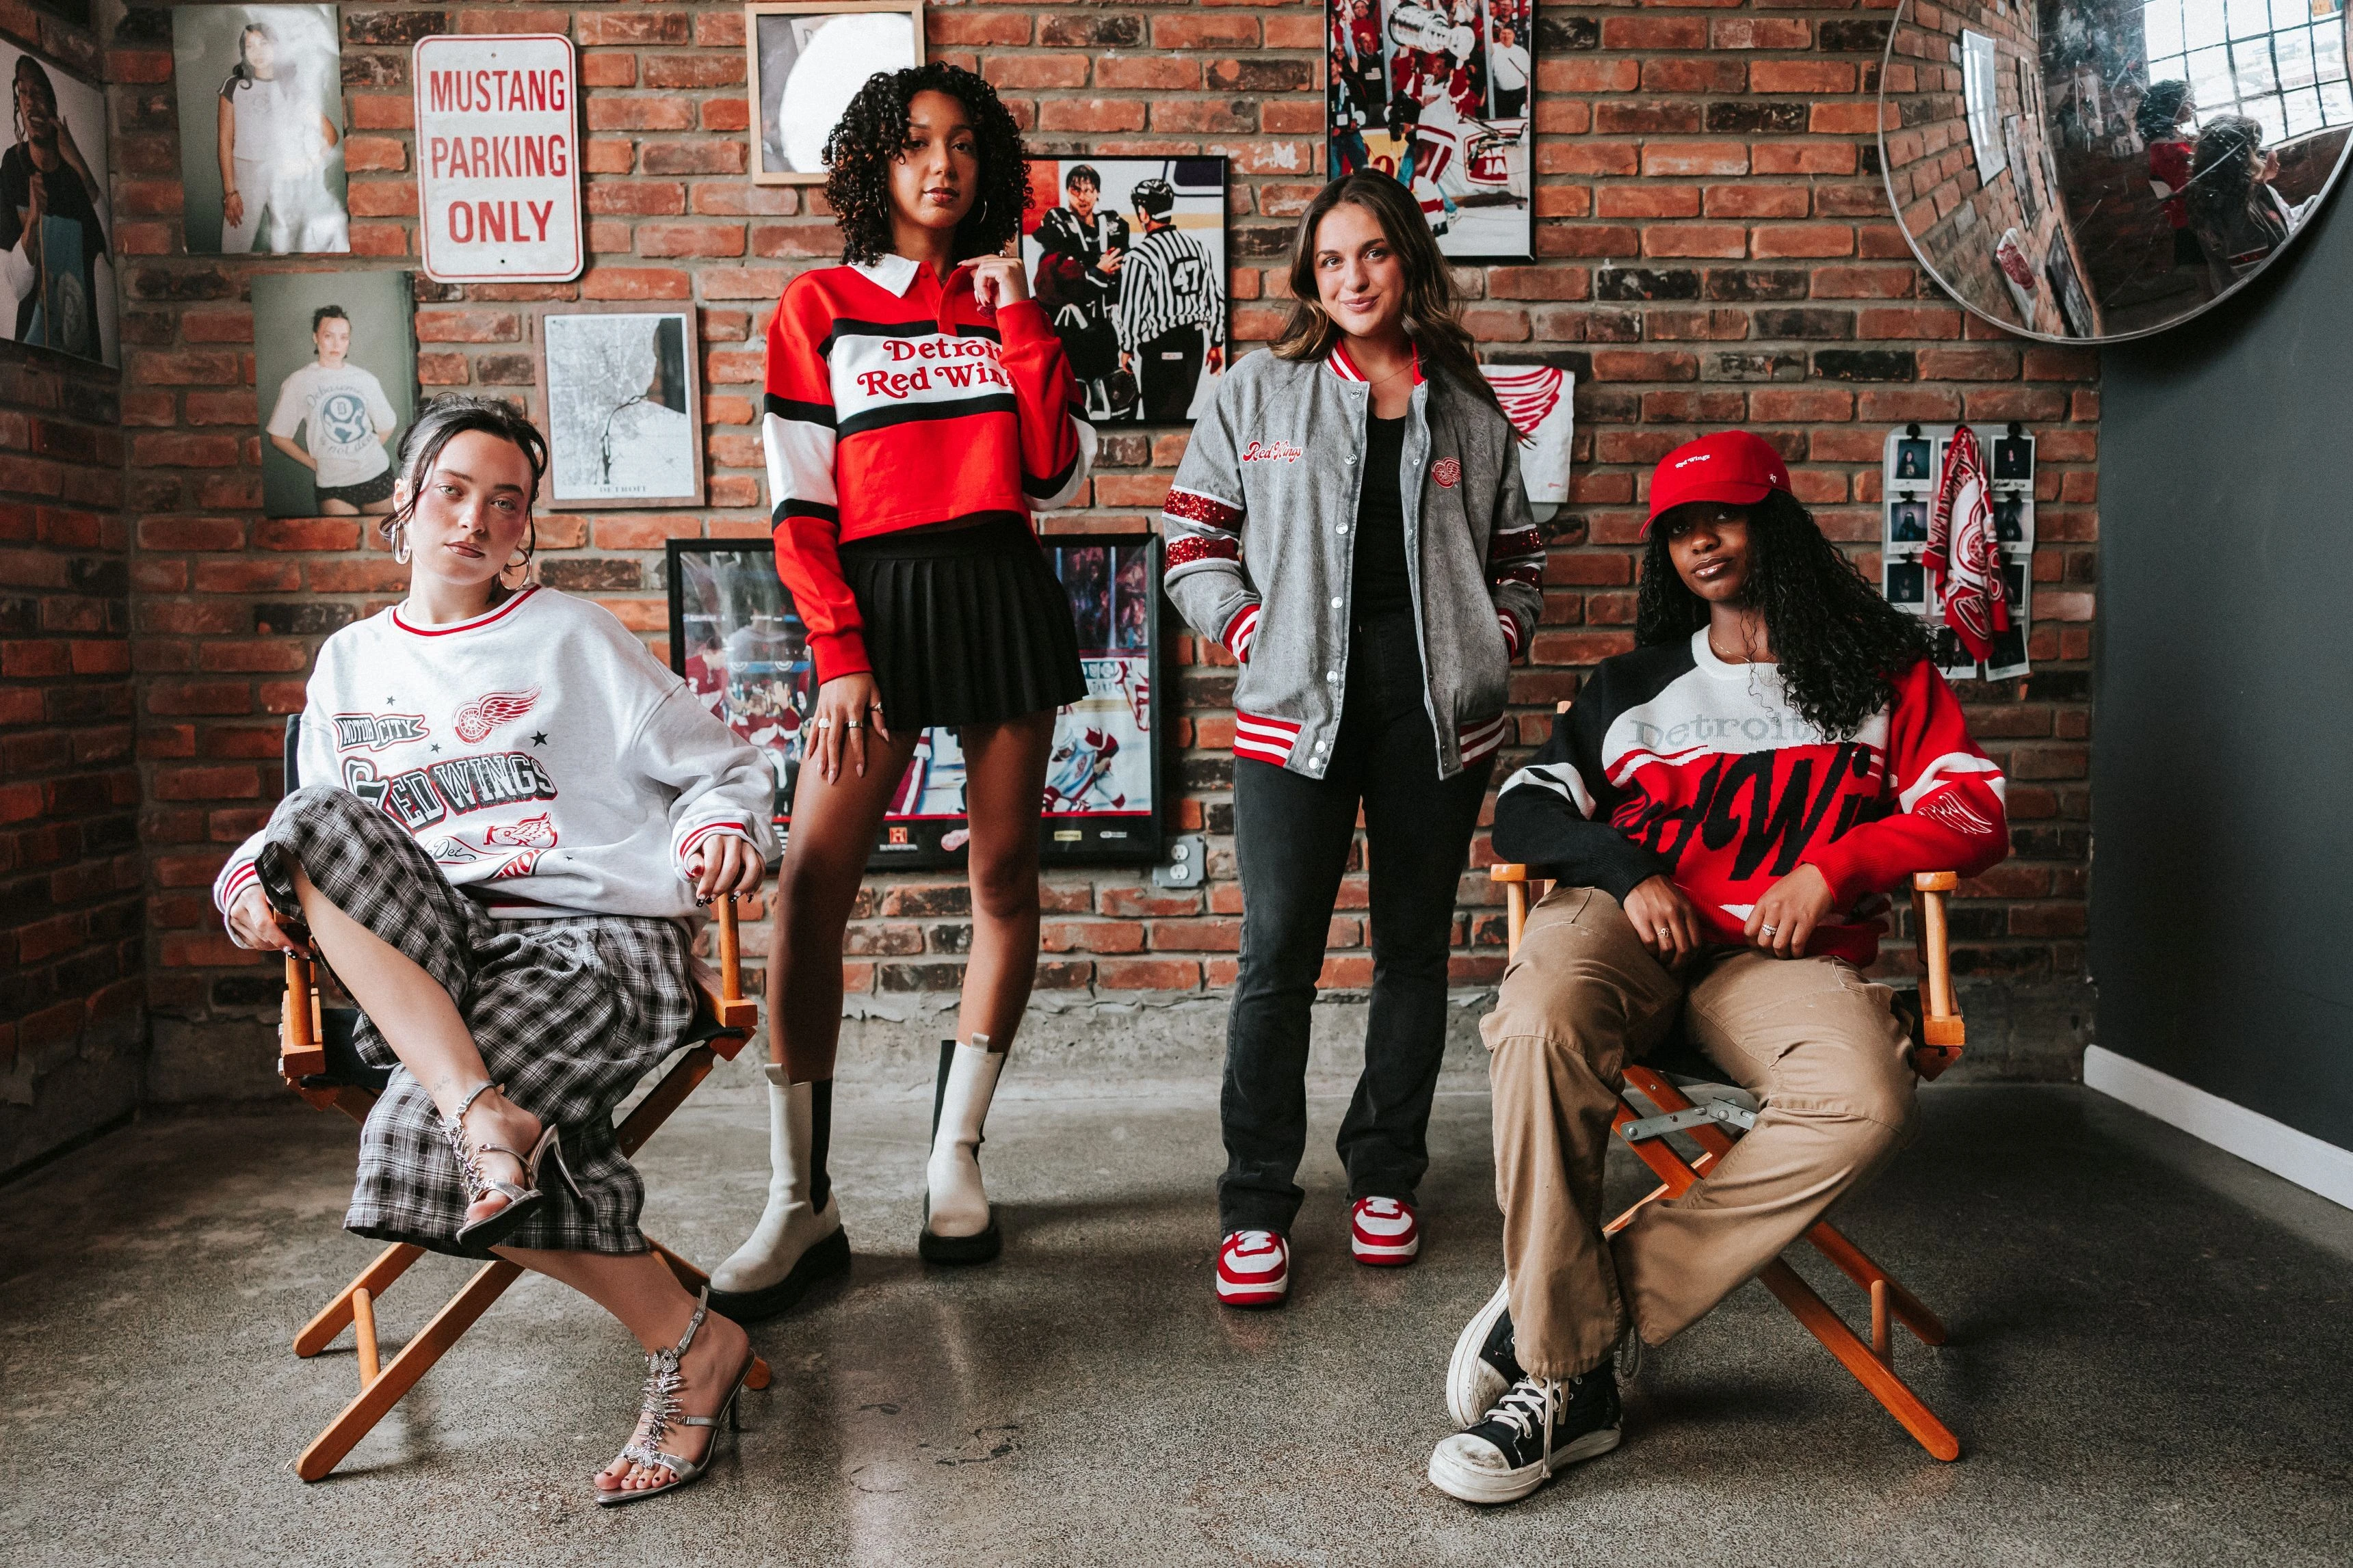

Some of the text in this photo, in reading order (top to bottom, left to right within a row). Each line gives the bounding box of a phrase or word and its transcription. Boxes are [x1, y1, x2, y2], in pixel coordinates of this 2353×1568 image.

[430, 69, 565, 112] MUSTANG
[431, 134, 567, 178] PARKING
[448, 200, 554, 243] ONLY
[1172, 259, 1200, 293] 47
[857, 361, 1016, 399] Red Win
[1242, 440, 1303, 464] Red Wings
[1675, 454, 1711, 468] Red Wings
[339, 718, 413, 744] MOTOR CITY
[342, 752, 558, 836] RED WINGS
